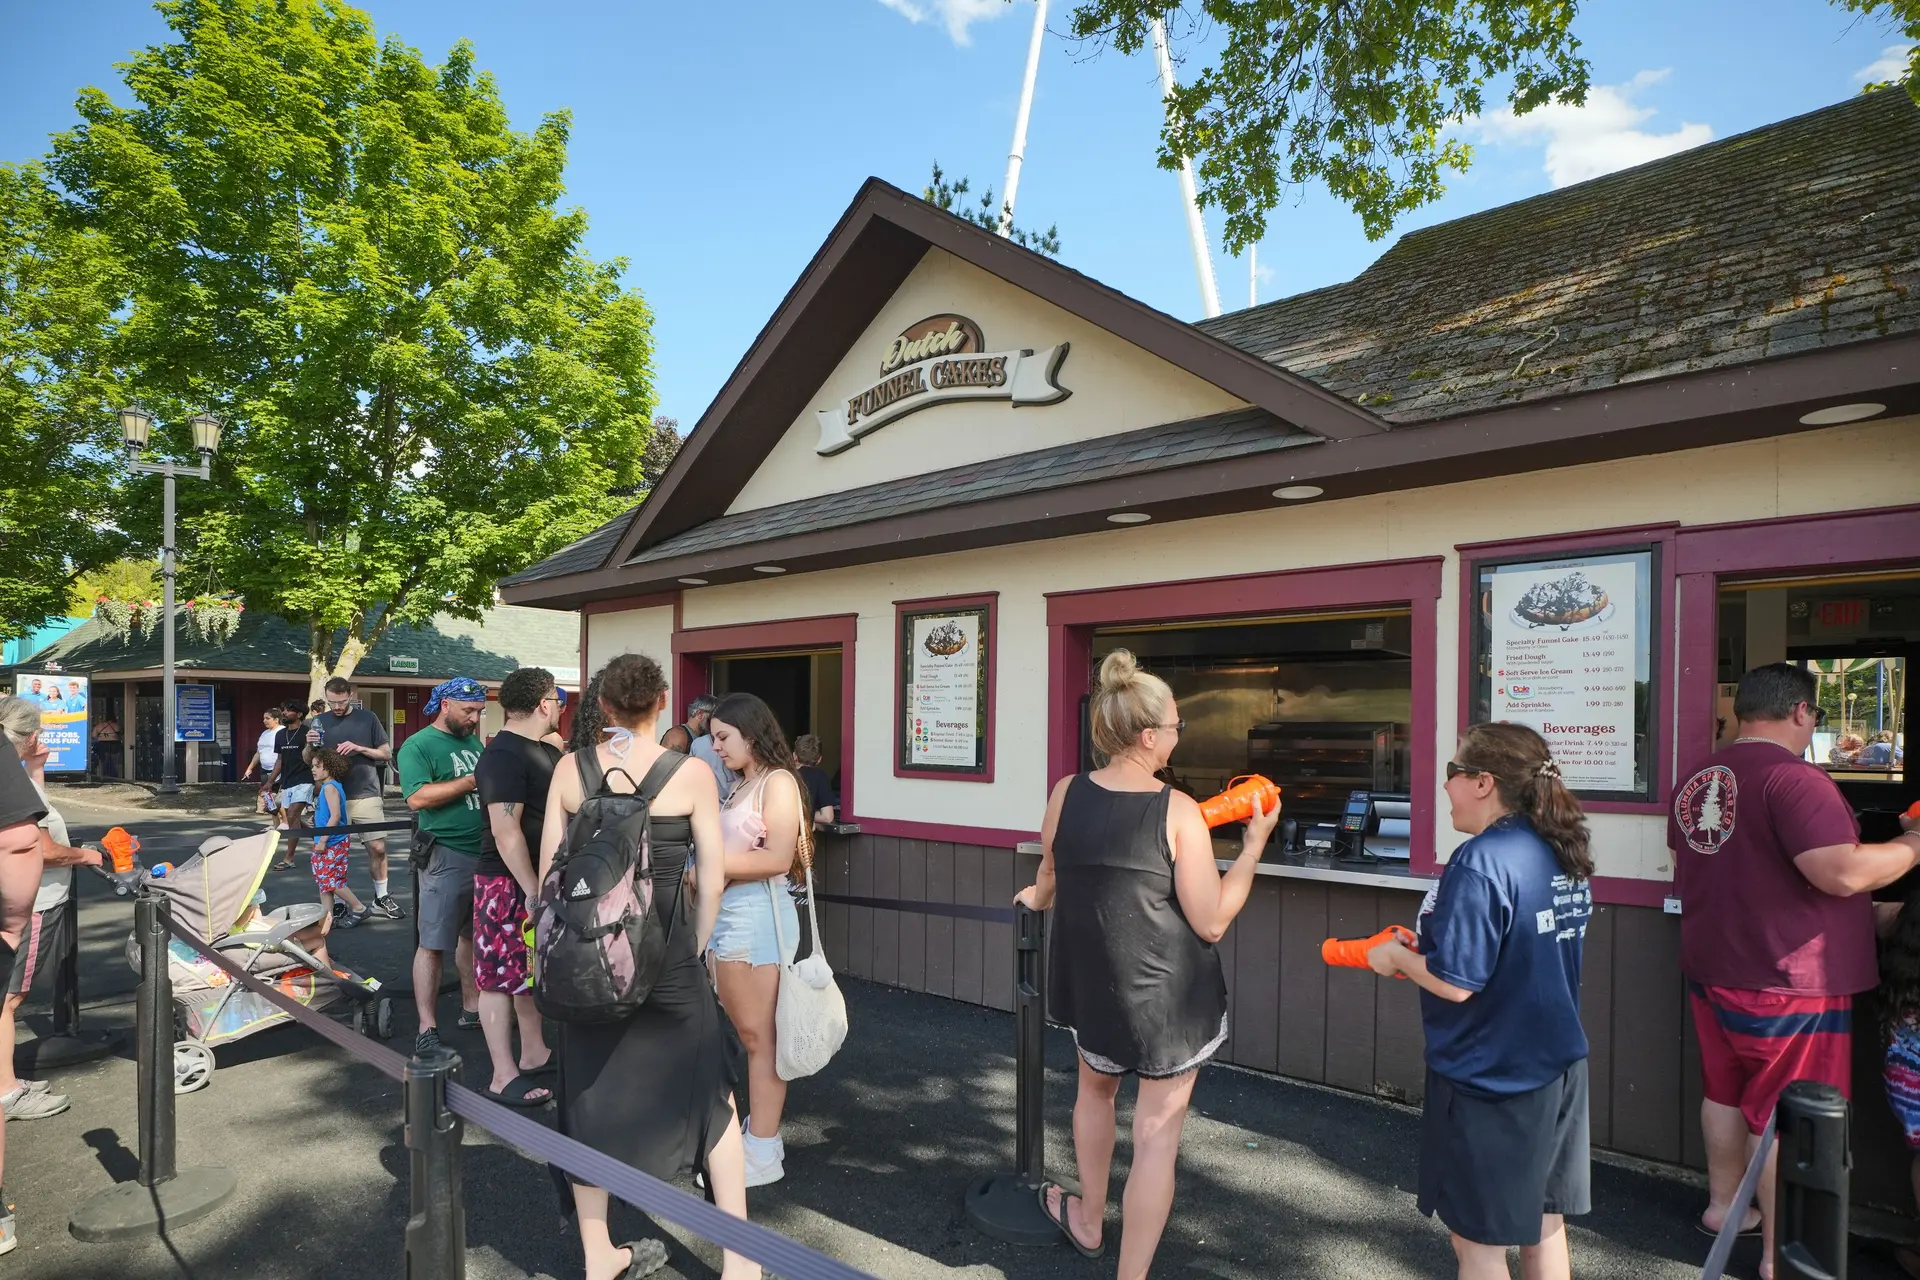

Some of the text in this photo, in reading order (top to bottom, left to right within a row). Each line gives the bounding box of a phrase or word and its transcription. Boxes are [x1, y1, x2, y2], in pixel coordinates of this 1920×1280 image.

[883, 321, 967, 371] Dutch
[848, 356, 1007, 426] FUNNEL CAKES
[1822, 601, 1861, 626] EXIT
[392, 660, 418, 668] LADIES
[936, 720, 968, 730] Beverages
[1543, 722, 1616, 736] Beverages
[1681, 781, 1699, 827] COLUMBIA
[1701, 772, 1734, 806] SPRTSWEAR
[571, 888, 591, 897] adidas
